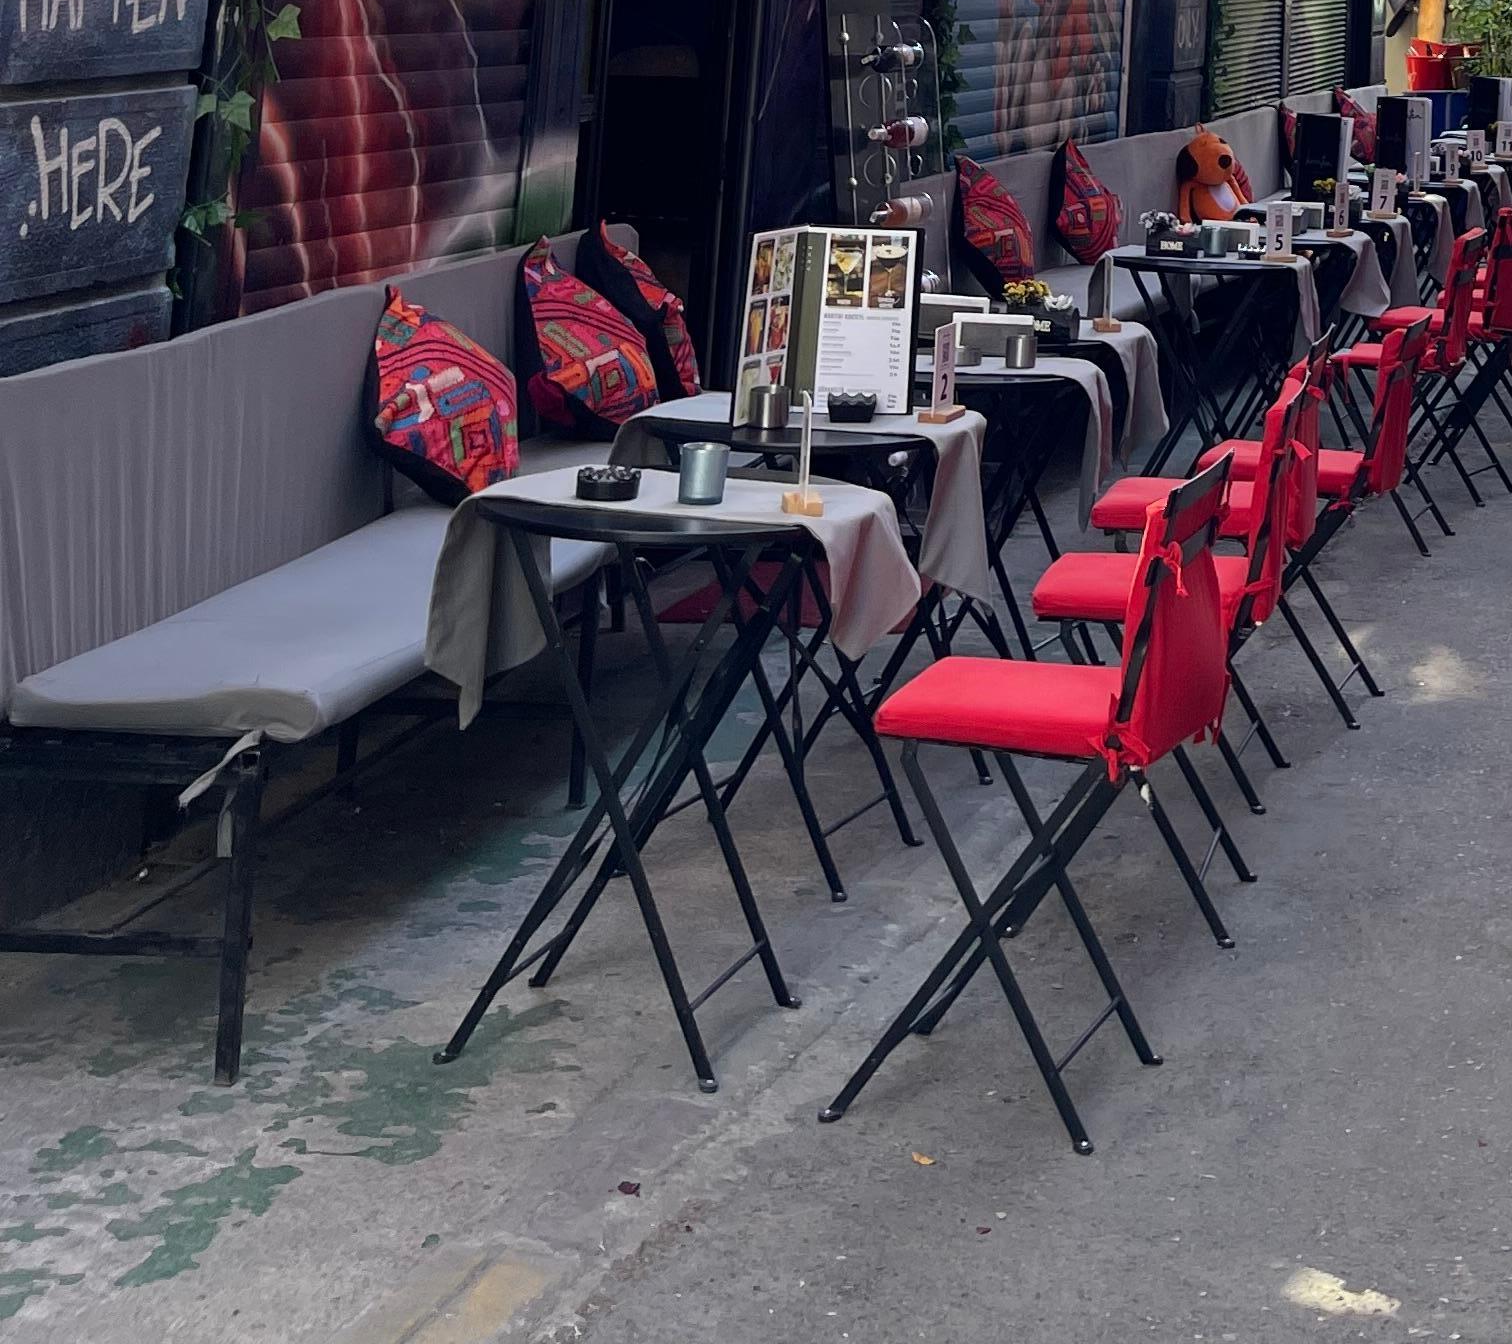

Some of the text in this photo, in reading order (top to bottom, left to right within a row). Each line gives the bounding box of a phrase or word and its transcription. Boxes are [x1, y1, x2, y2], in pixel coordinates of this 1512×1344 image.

[1502, 141, 1512, 152] 11
[1471, 150, 1482, 162] 10
[33, 115, 163, 230] HERE
[1450, 166, 1455, 176] 9
[1379, 195, 1388, 210] 7
[1338, 210, 1345, 225] 6
[1274, 233, 1283, 251] 5
[940, 373, 948, 401] 2
